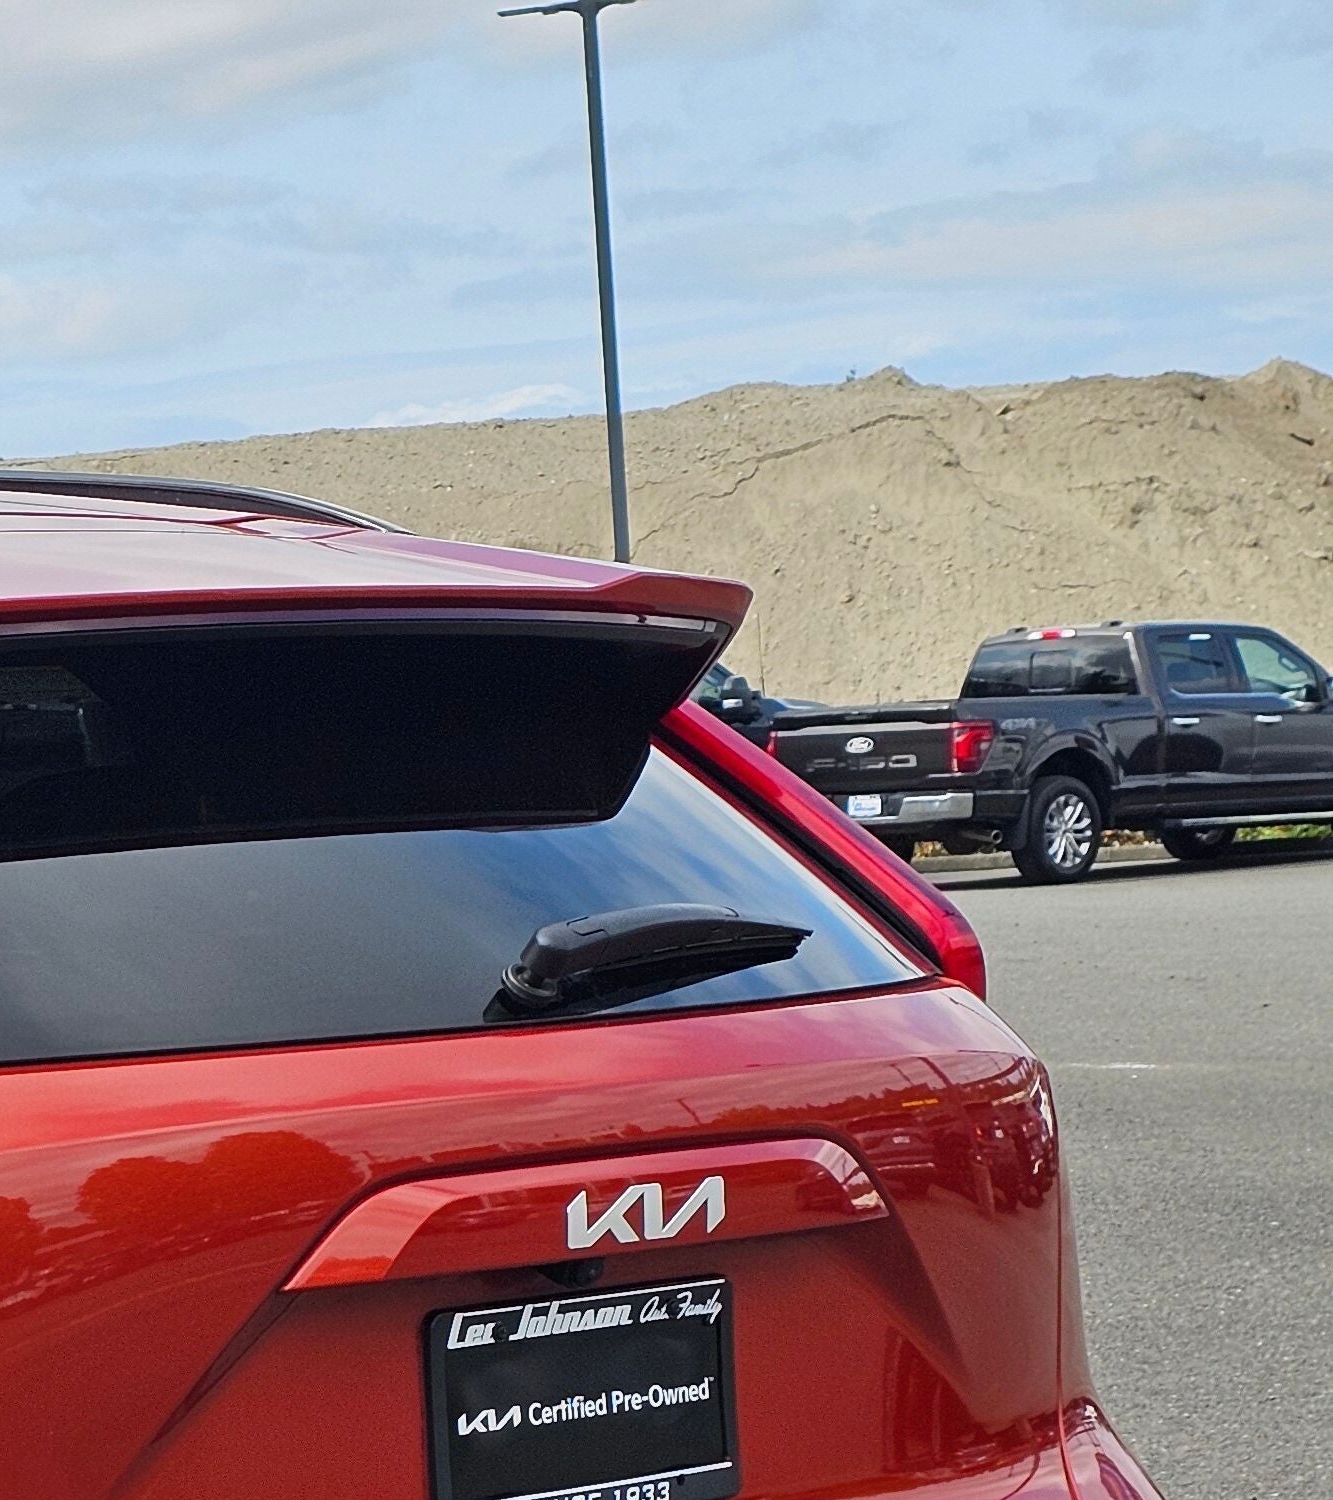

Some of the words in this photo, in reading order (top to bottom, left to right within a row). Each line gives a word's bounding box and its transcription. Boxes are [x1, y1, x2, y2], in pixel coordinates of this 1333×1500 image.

[567, 1175, 726, 1250] KIA
[508, 1301, 634, 1341] Johnson
[676, 1288, 723, 1324] Family
[457, 1405, 522, 1436] KIA
[528, 1392, 608, 1426] Certified
[610, 1379, 711, 1414] Pre-Owned
